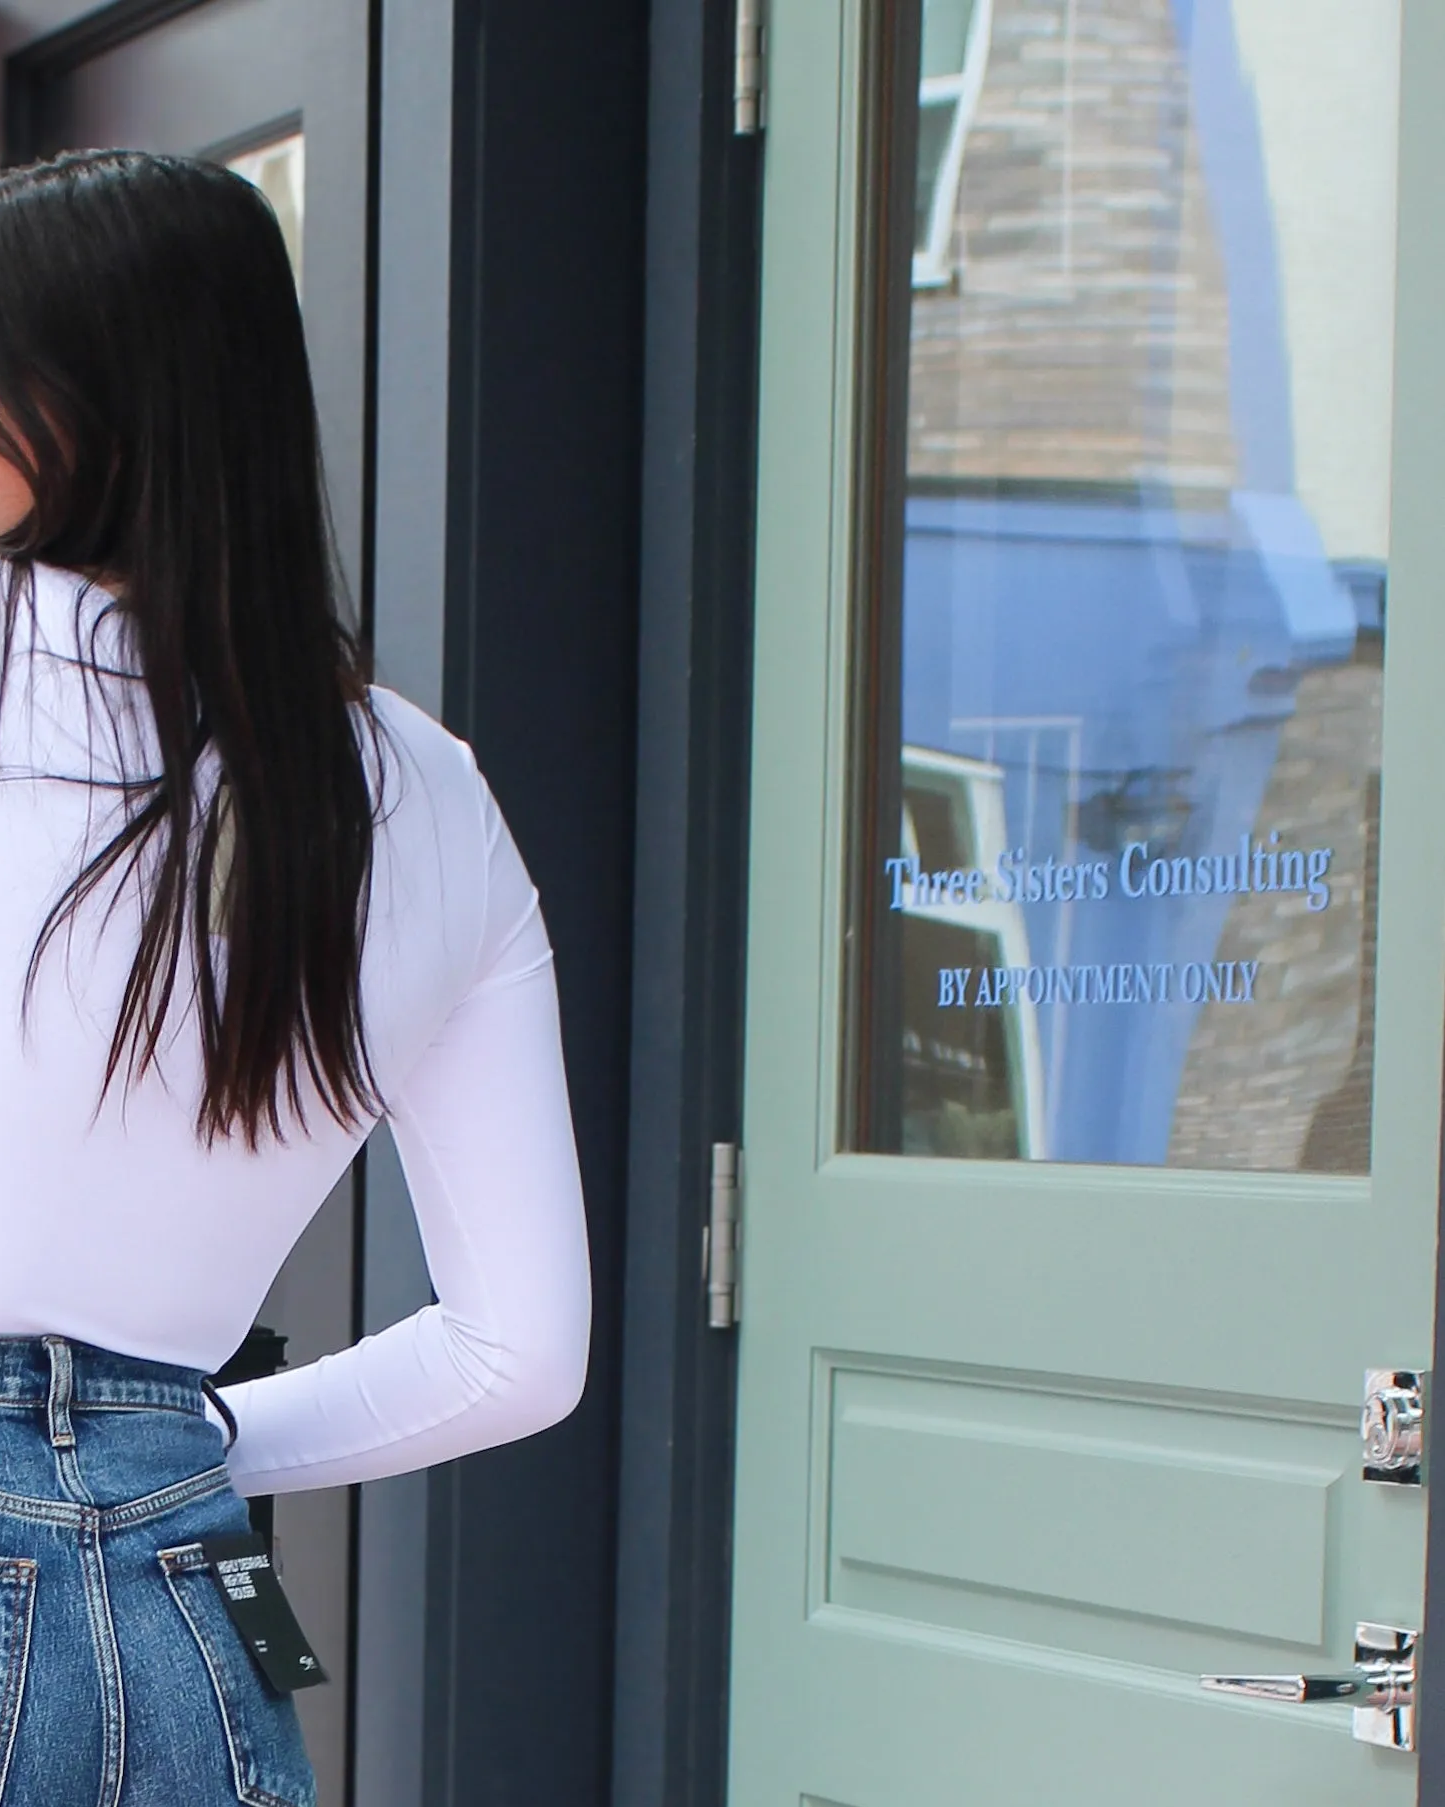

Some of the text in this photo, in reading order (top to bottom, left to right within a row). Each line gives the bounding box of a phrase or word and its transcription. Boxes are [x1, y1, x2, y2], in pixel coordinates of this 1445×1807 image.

[885, 830, 1333, 912] Three Sisters Consulting
[937, 960, 1260, 1007] BY APPOINTMENT ONLY
